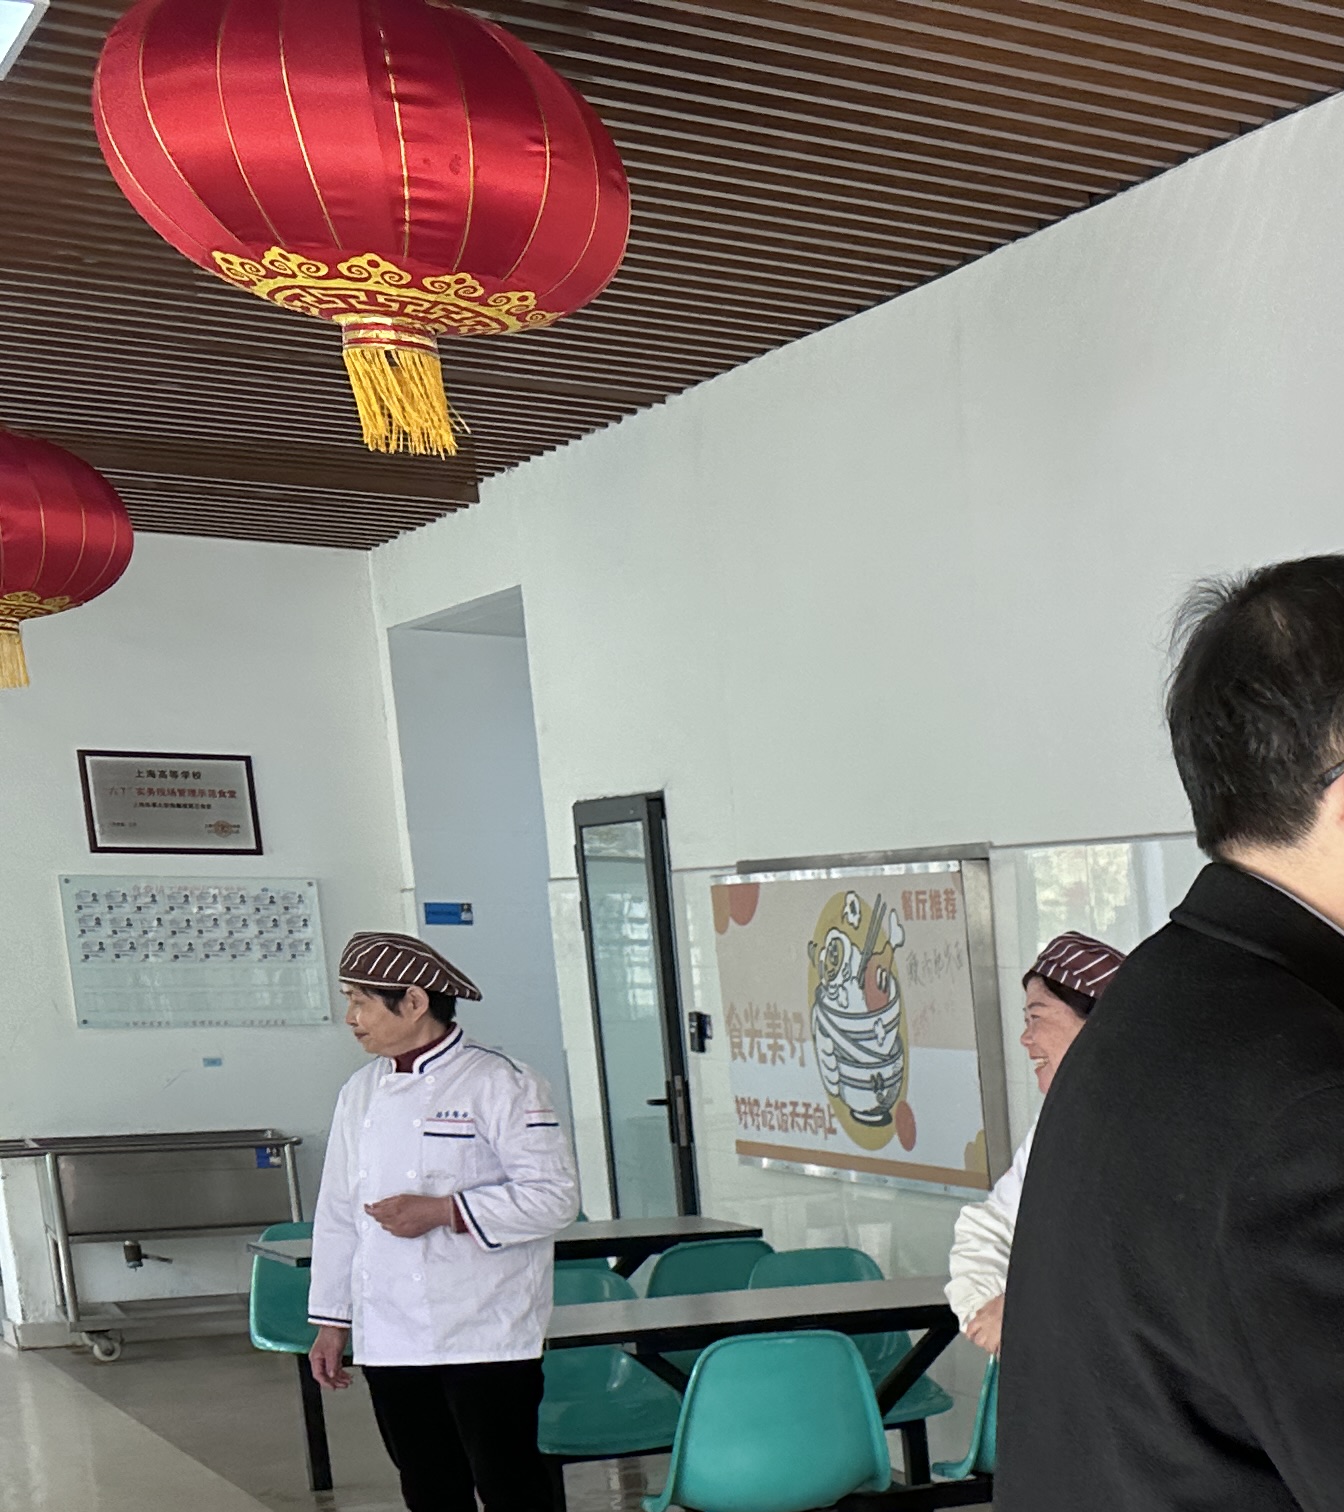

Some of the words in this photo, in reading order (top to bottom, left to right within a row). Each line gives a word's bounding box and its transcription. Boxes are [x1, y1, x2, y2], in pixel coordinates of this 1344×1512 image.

[901, 888, 956, 921] 餐厅推荐
[725, 1001, 806, 1068] 食光美好
[735, 1095, 837, 1140] 好好吃饭天天向上
